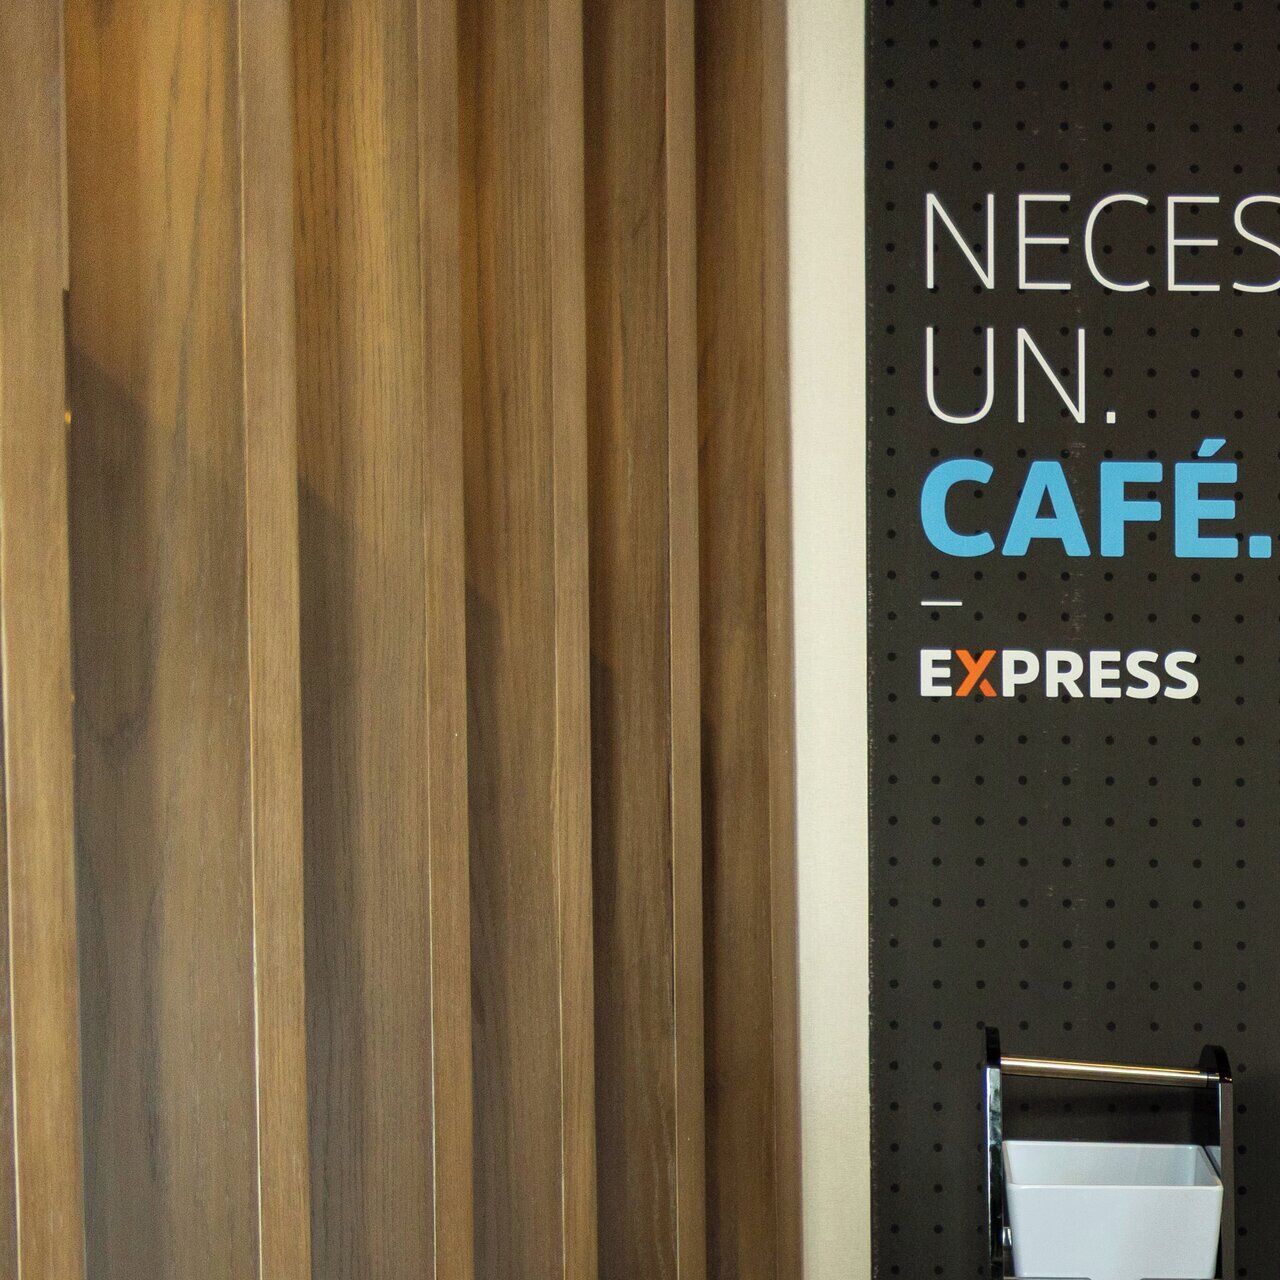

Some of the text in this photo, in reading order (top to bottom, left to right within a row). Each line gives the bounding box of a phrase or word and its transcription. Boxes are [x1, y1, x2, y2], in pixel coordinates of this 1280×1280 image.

[926, 327, 1117, 425] UN.
[920, 438, 1273, 559] CAFÉ.
[920, 649, 1200, 701] EXPRESS
